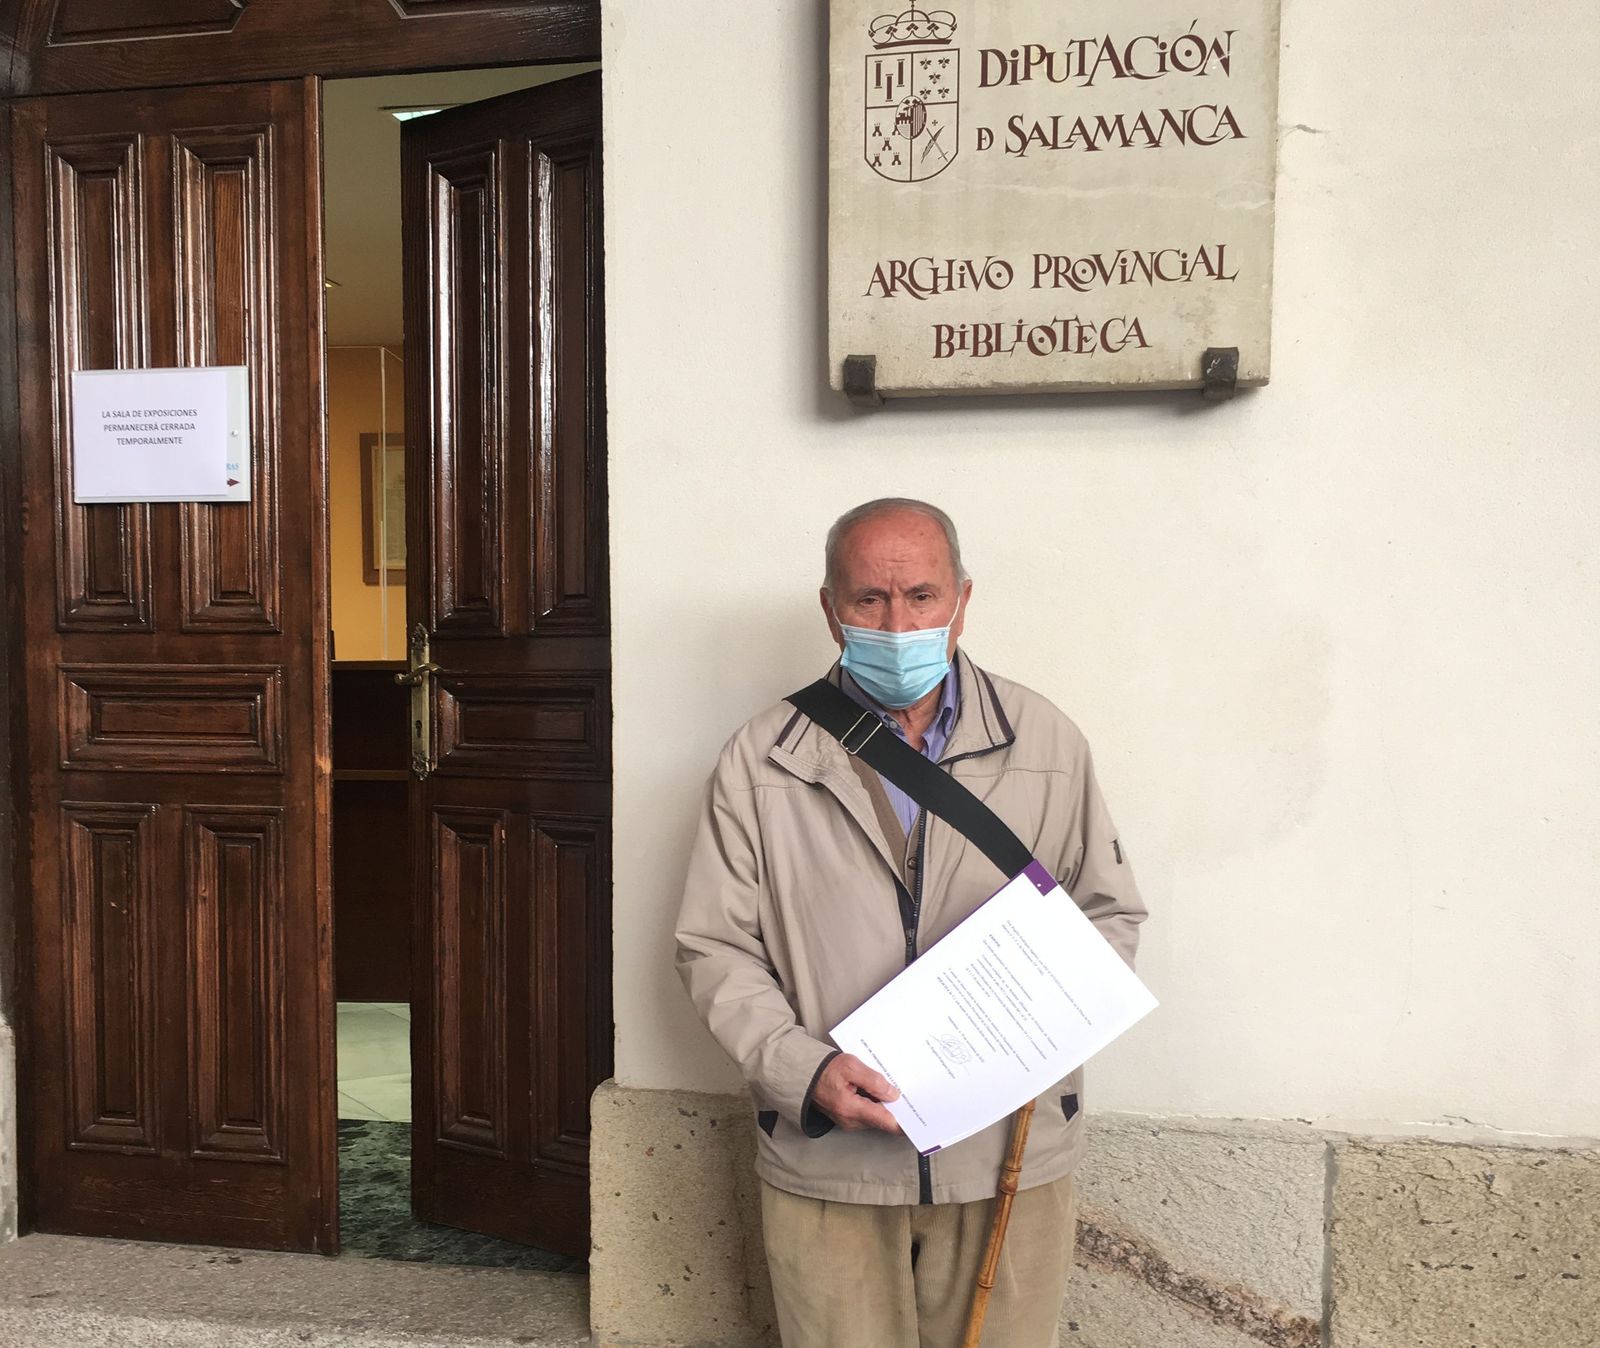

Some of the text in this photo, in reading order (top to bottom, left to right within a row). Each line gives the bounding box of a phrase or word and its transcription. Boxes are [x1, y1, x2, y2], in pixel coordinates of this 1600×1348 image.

[1005, 104, 1247, 157] SALAMANCA
[112, 410, 131, 418] SALA
[143, 409, 198, 417] EXPOSICIONES
[103, 422, 196, 431] PERMANECERÁ CERRADA
[116, 437, 183, 445] TEMPORALMENTE
